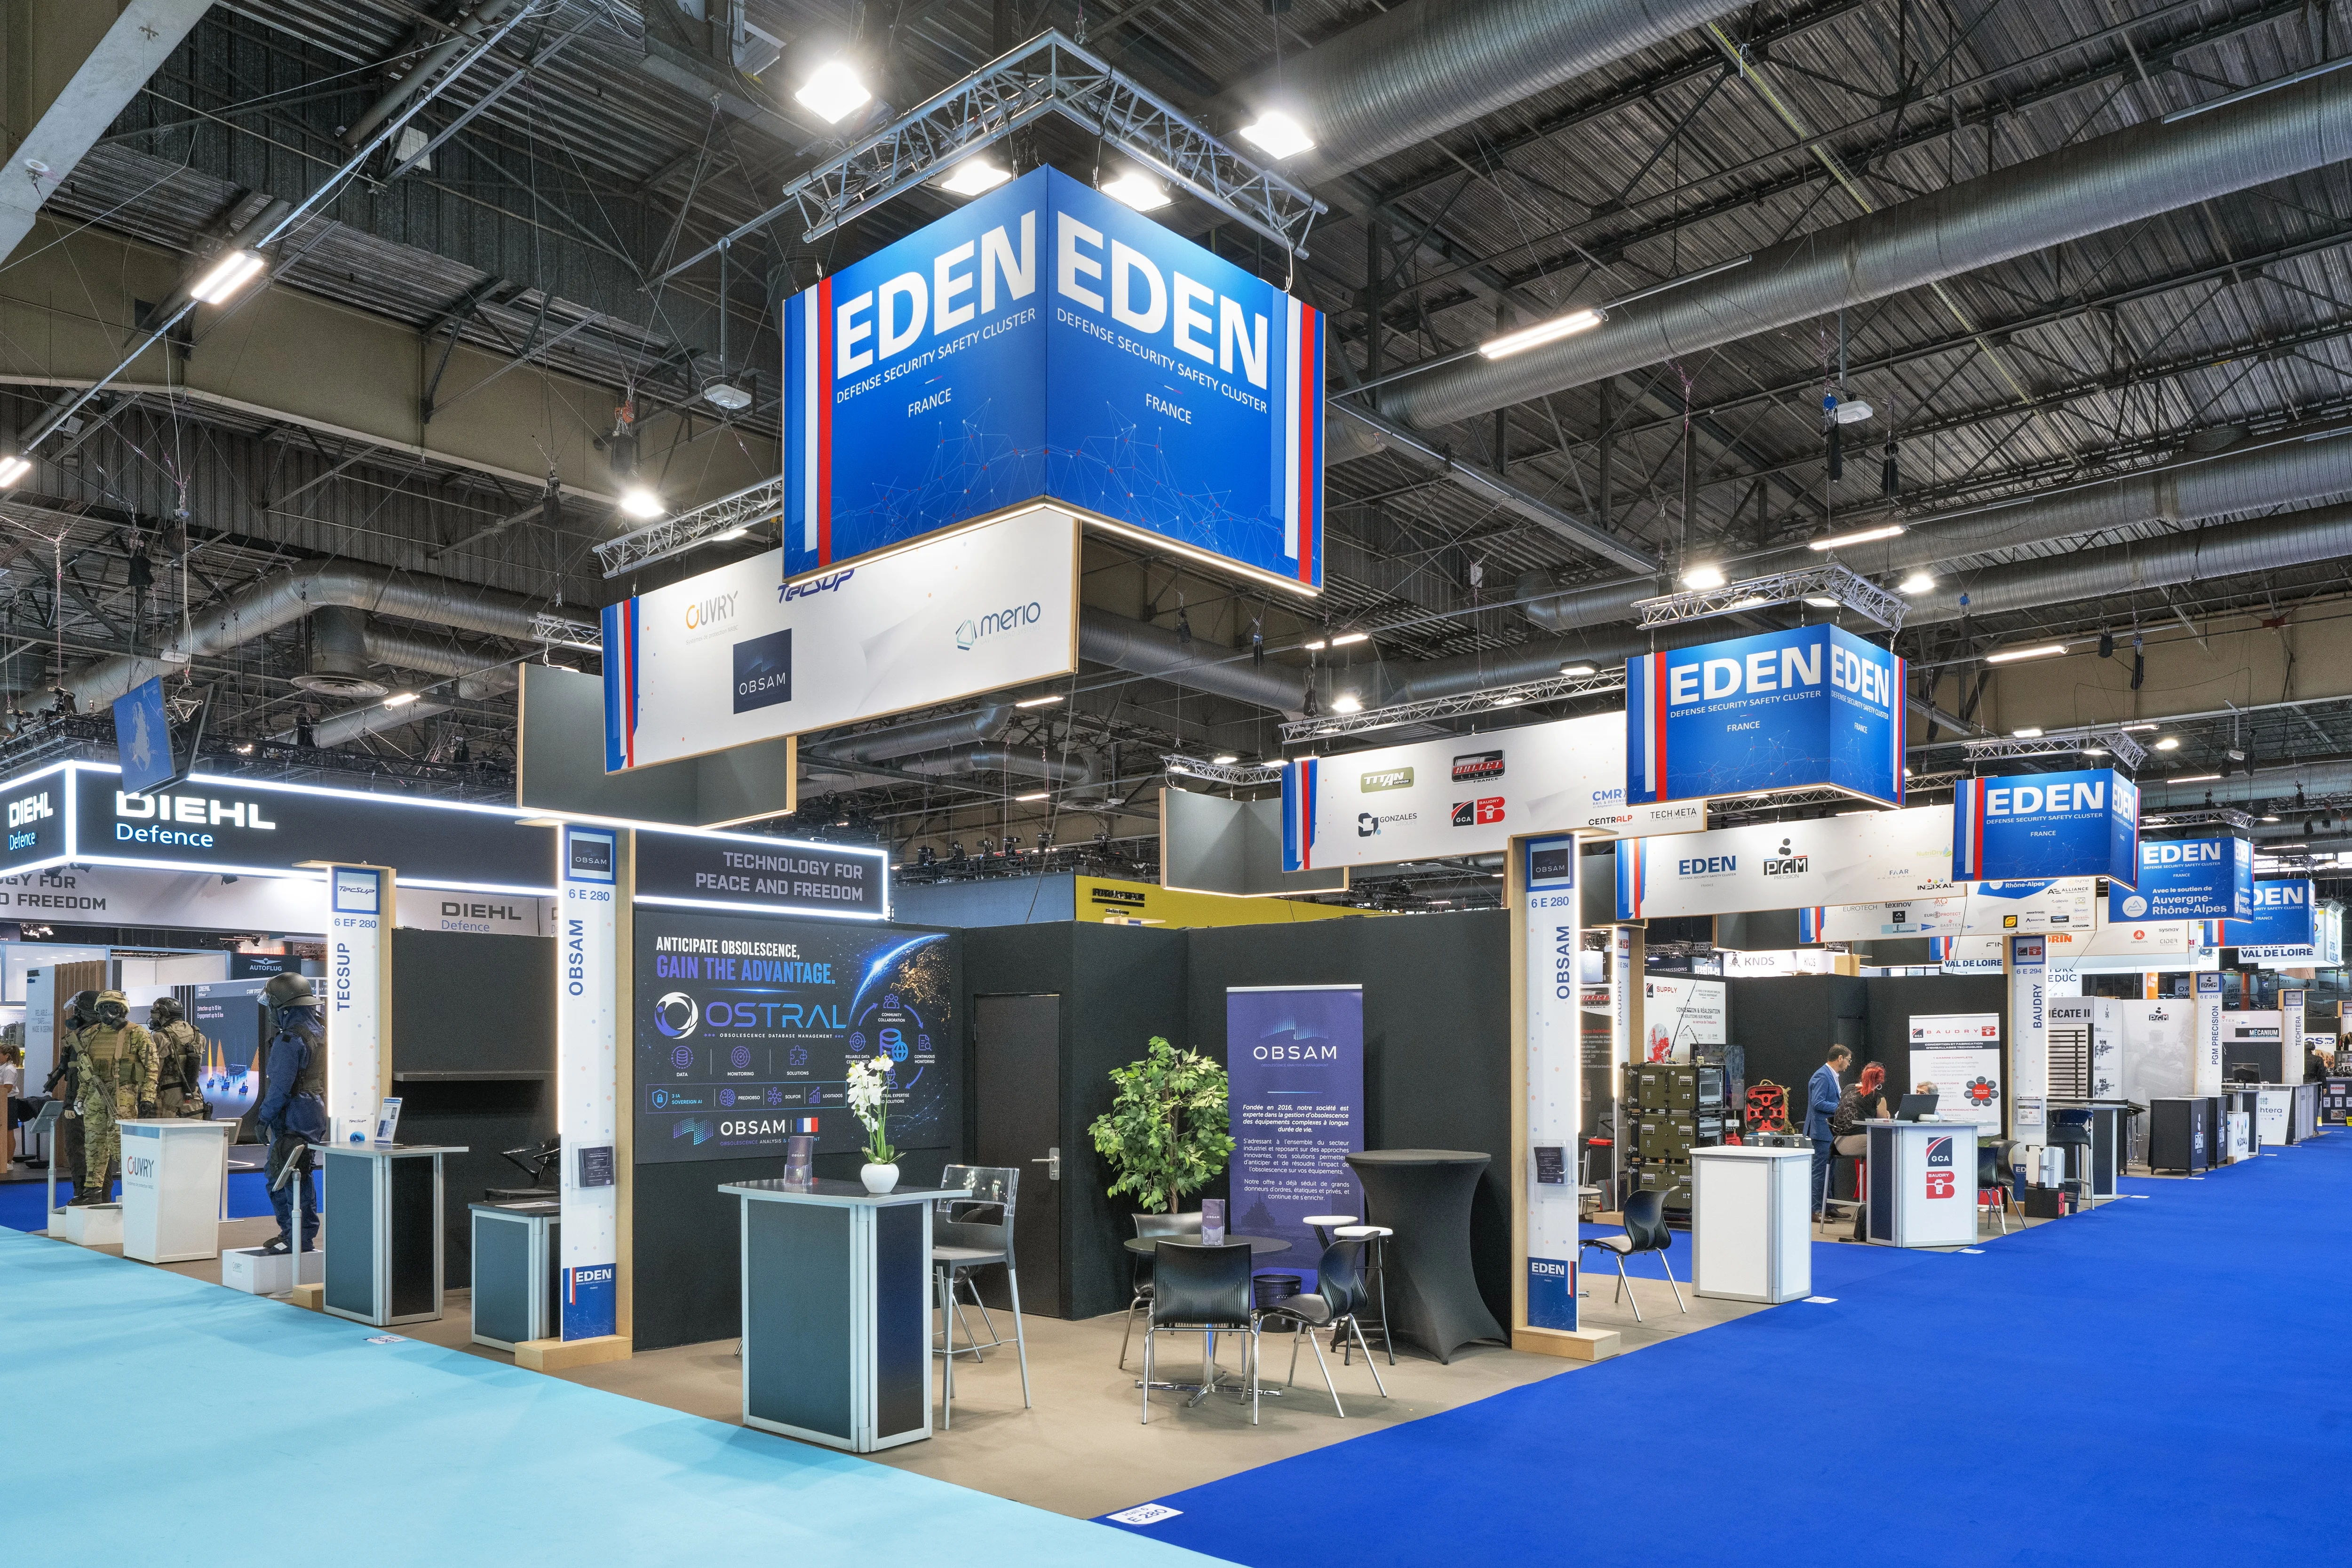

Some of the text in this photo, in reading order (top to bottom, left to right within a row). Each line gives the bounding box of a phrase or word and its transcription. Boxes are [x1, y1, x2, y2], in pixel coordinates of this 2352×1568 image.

[837, 210, 1035, 379] EDEN
[1057, 211, 1267, 390] EDEN
[837, 308, 1035, 403] DEFENSE SECURITY SAFETY CLUSTER
[908, 388, 951, 417] FRANCE
[1146, 394, 1192, 425] FRANCE
[686, 590, 738, 629] OUVRY
[709, 629, 727, 639] protection
[739, 672, 785, 695] OBSAM
[1670, 644, 1821, 706] EDEN
[1831, 644, 1889, 707] EDEN
[1727, 721, 1760, 732] FRANCE
[1455, 762, 1499, 773] BULLET
[1364, 772, 1404, 787] TITAN
[1987, 781, 2104, 816] EDEN
[9, 792, 53, 828] DIEHL
[116, 791, 276, 829] DIEHL
[1380, 813, 1417, 823] GONZALES
[9, 832, 35, 851] Defence
[116, 823, 214, 847] Defence
[575, 856, 607, 865] OBSAM
[2143, 843, 2220, 864] EDEN
[723, 852, 862, 879] TECHNOLOGY FOR
[1679, 855, 1736, 875] EDEN
[40, 875, 75, 889] FOR
[696, 873, 863, 901] PEACE AND FREEDOM
[18, 894, 105, 910] FREEDOM
[442, 901, 521, 920] DIEHL
[1531, 896, 1569, 907] 6 E 280
[2153, 895, 2213, 907] Auvergne-
[2153, 904, 2226, 915] Rhône-Alpes
[442, 920, 490, 932] Defence
[569, 919, 583, 996] OBSAM
[656, 937, 800, 959] ANTICIPATE OBSOLESCENCE,
[657, 955, 835, 984] GAIN THE ADVANTAGE.
[1556, 926, 1570, 999] OBSAM
[1745, 957, 1774, 965] KNDS
[337, 943, 350, 1011] TECSUP
[706, 1002, 846, 1028] OSTRAL
[2033, 984, 2042, 1028] BAUDRY
[1254, 1046, 1336, 1059] OBSAM
[721, 1120, 785, 1135] OBSAM
[127, 1156, 154, 1178] OUVRY
[576, 1269, 611, 1282] EDEN
[1532, 1262, 1564, 1275] EDEN
[1139, 1509, 1167, 1519] 280
